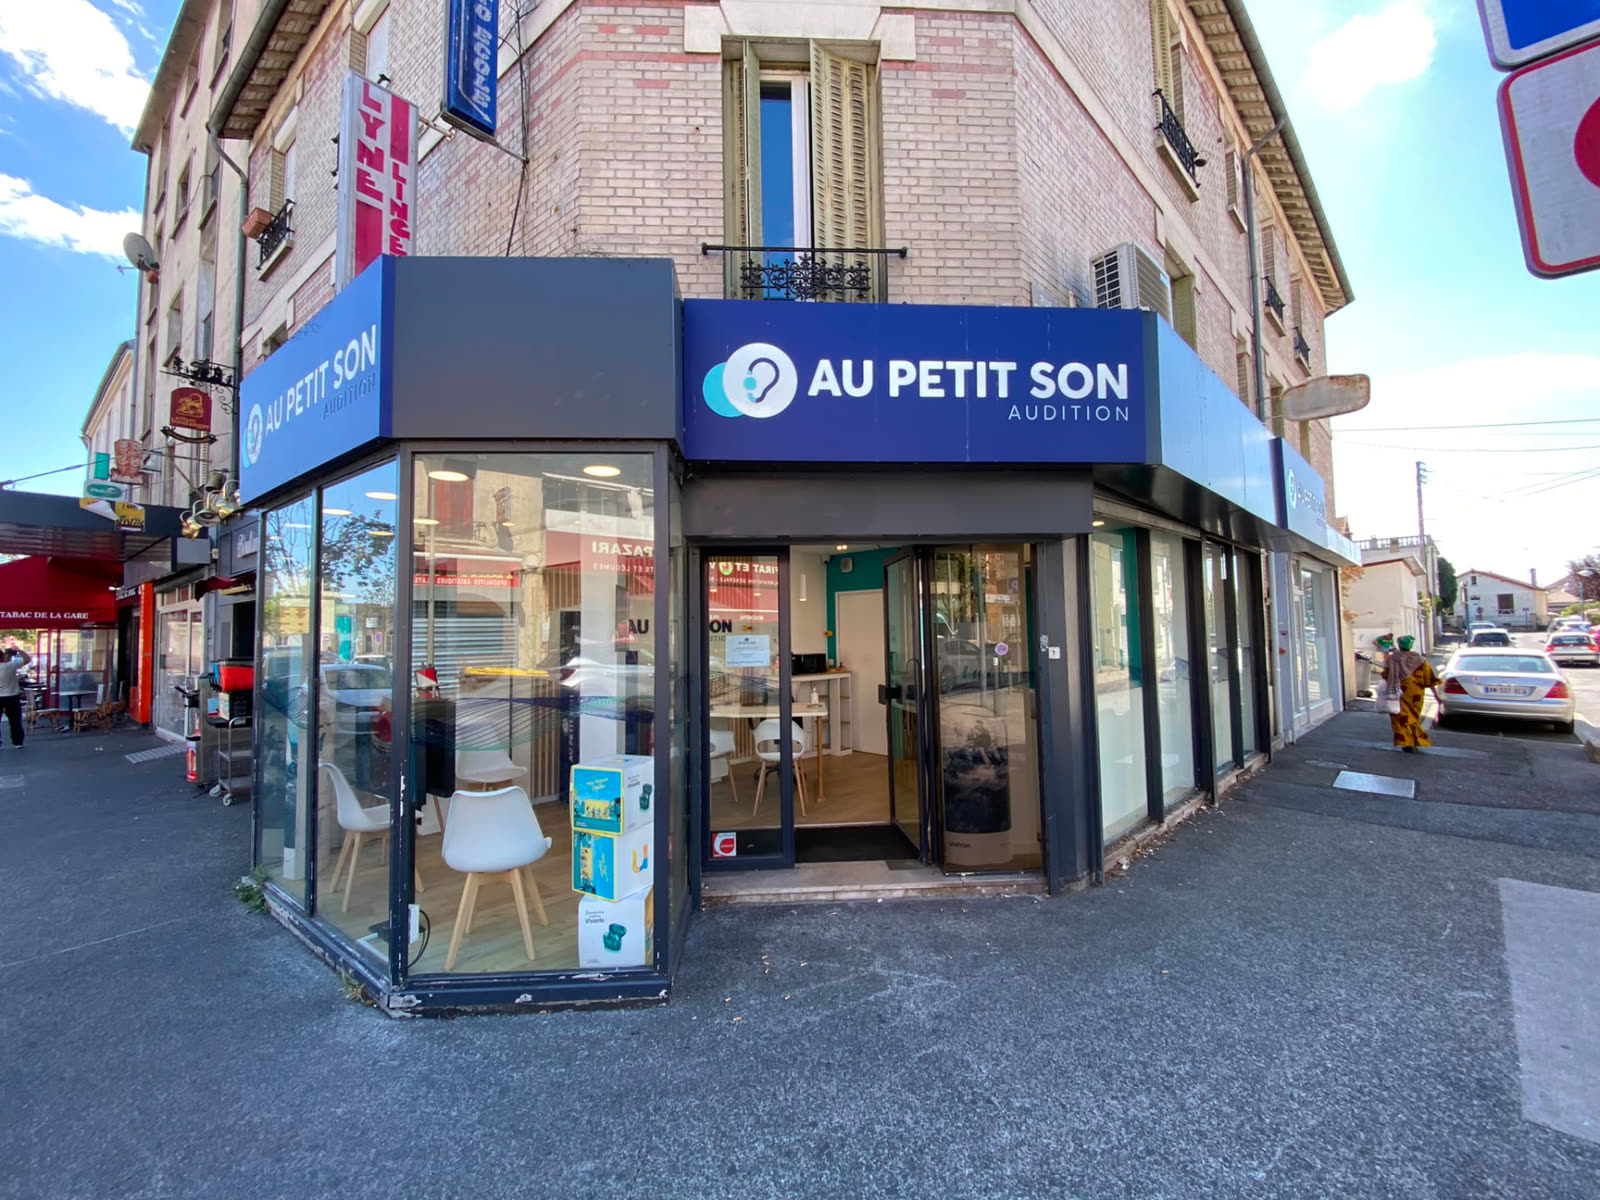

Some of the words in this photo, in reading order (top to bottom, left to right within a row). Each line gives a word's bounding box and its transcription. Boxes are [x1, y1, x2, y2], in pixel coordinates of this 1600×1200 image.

[356, 81, 386, 203] LYNE
[266, 395, 283, 437] AU
[286, 360, 329, 422] PETIT
[333, 324, 376, 389] SON
[323, 372, 376, 421] AUDITION
[808, 359, 873, 397] AU
[889, 361, 1016, 398] PETIT
[1030, 362, 1128, 399] SON
[1008, 405, 1129, 421] AUDITION
[0, 611, 32, 619] TABAC
[629, 619, 649, 634] AU
